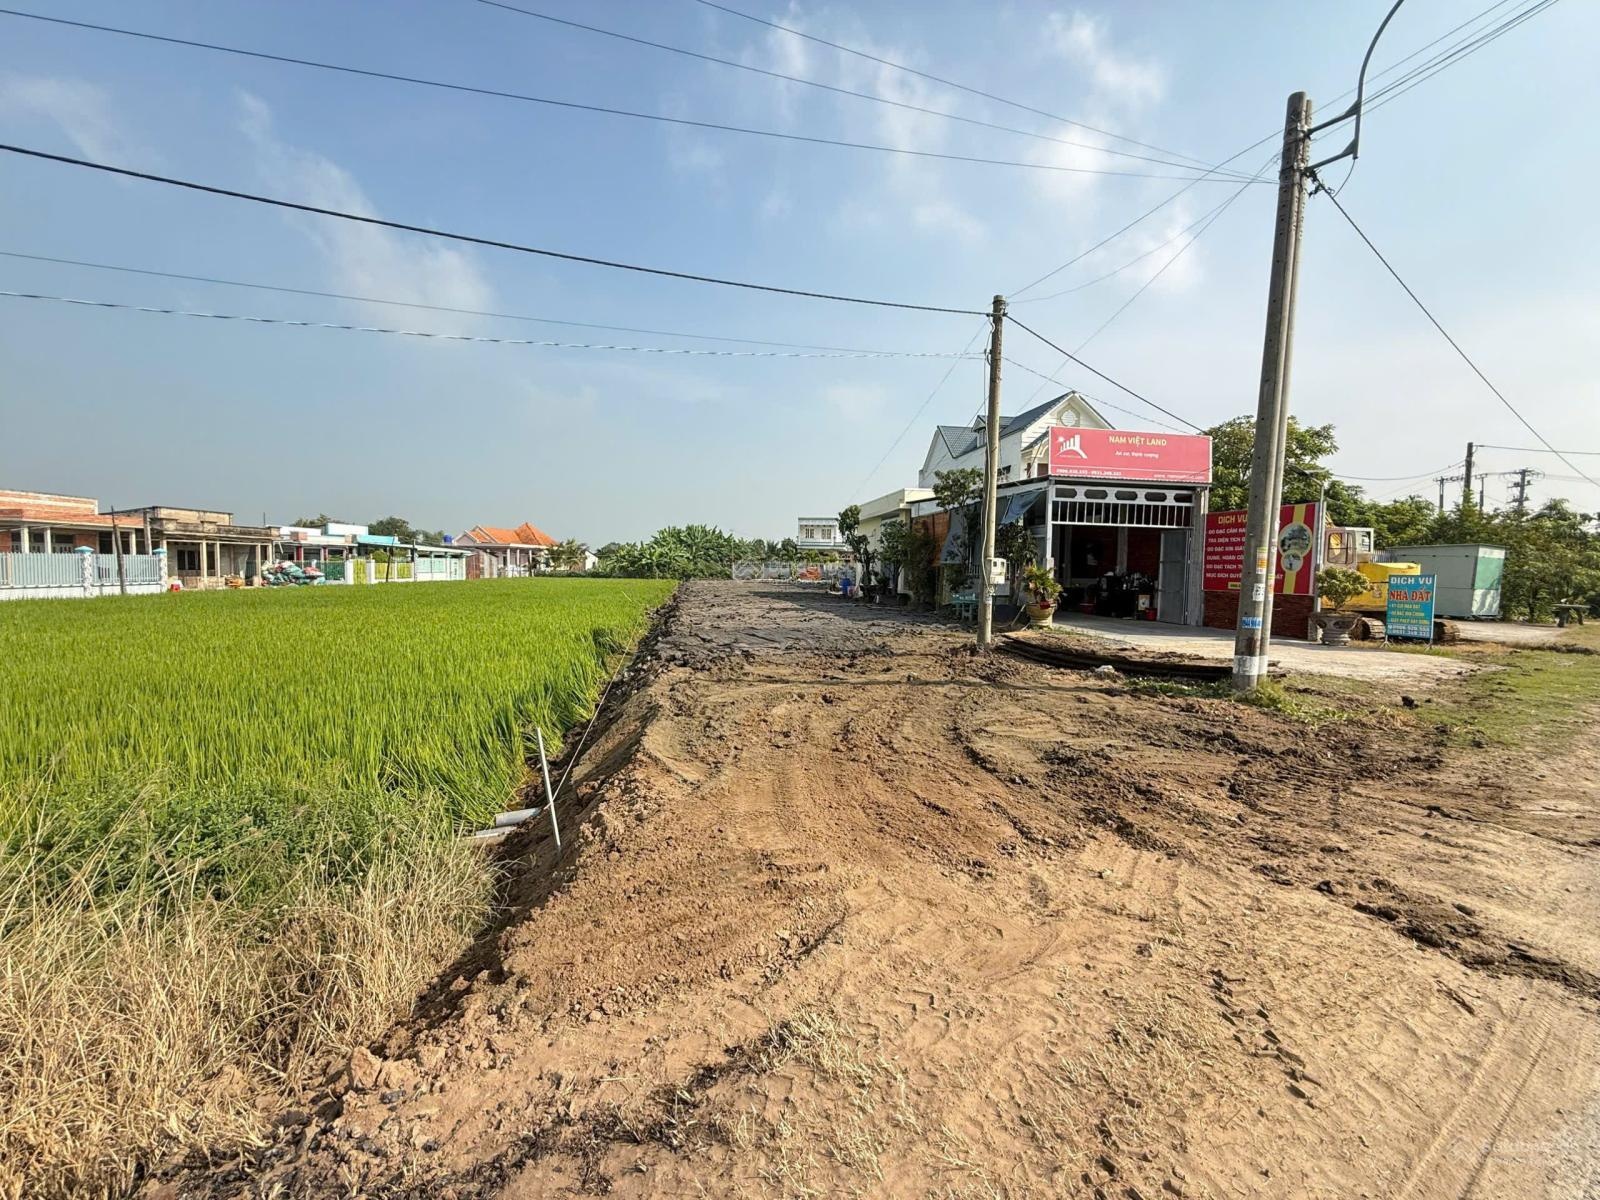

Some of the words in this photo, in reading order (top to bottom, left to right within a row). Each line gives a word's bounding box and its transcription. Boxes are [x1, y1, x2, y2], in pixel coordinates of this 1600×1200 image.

[1108, 435, 1126, 444] NAM
[1128, 436, 1145, 446] VIỆT
[1146, 438, 1167, 446] LAND
